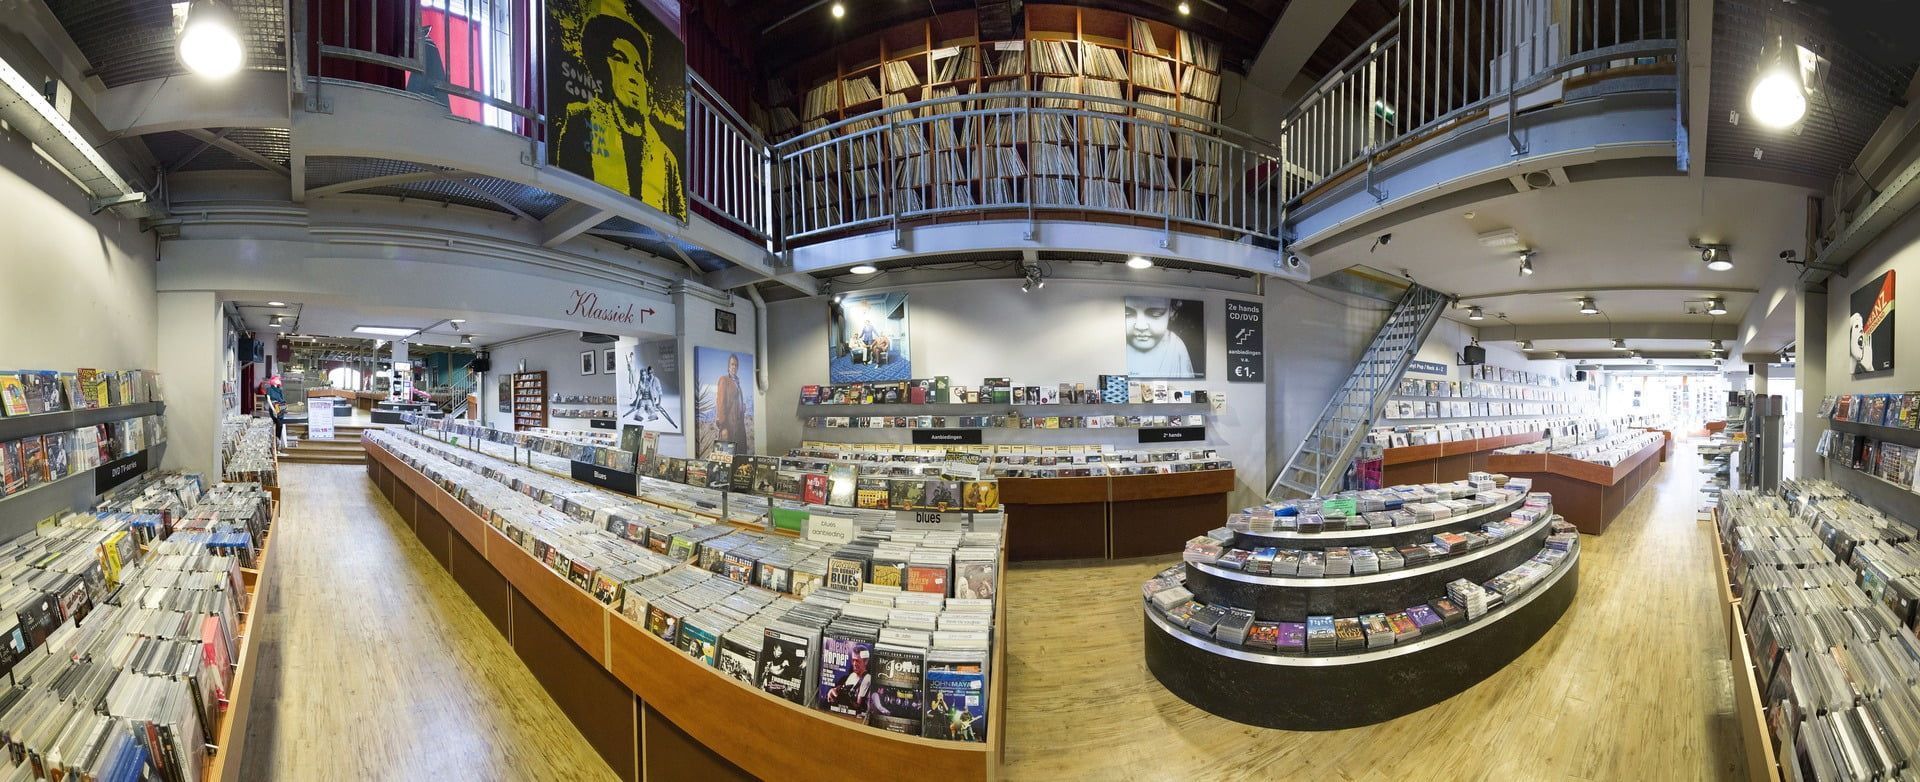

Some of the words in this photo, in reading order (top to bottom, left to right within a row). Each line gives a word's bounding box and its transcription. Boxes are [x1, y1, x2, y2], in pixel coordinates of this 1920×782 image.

[565, 289, 634, 323] Klassiek
[1228, 303, 1238, 311] 2e
[1239, 304, 1260, 313] hands
[1229, 312, 1259, 322] CD/DVD
[593, 470, 607, 480] Blues
[916, 512, 941, 523] blues
[812, 529, 845, 539] aanbieding
[831, 573, 858, 587] BLUES
